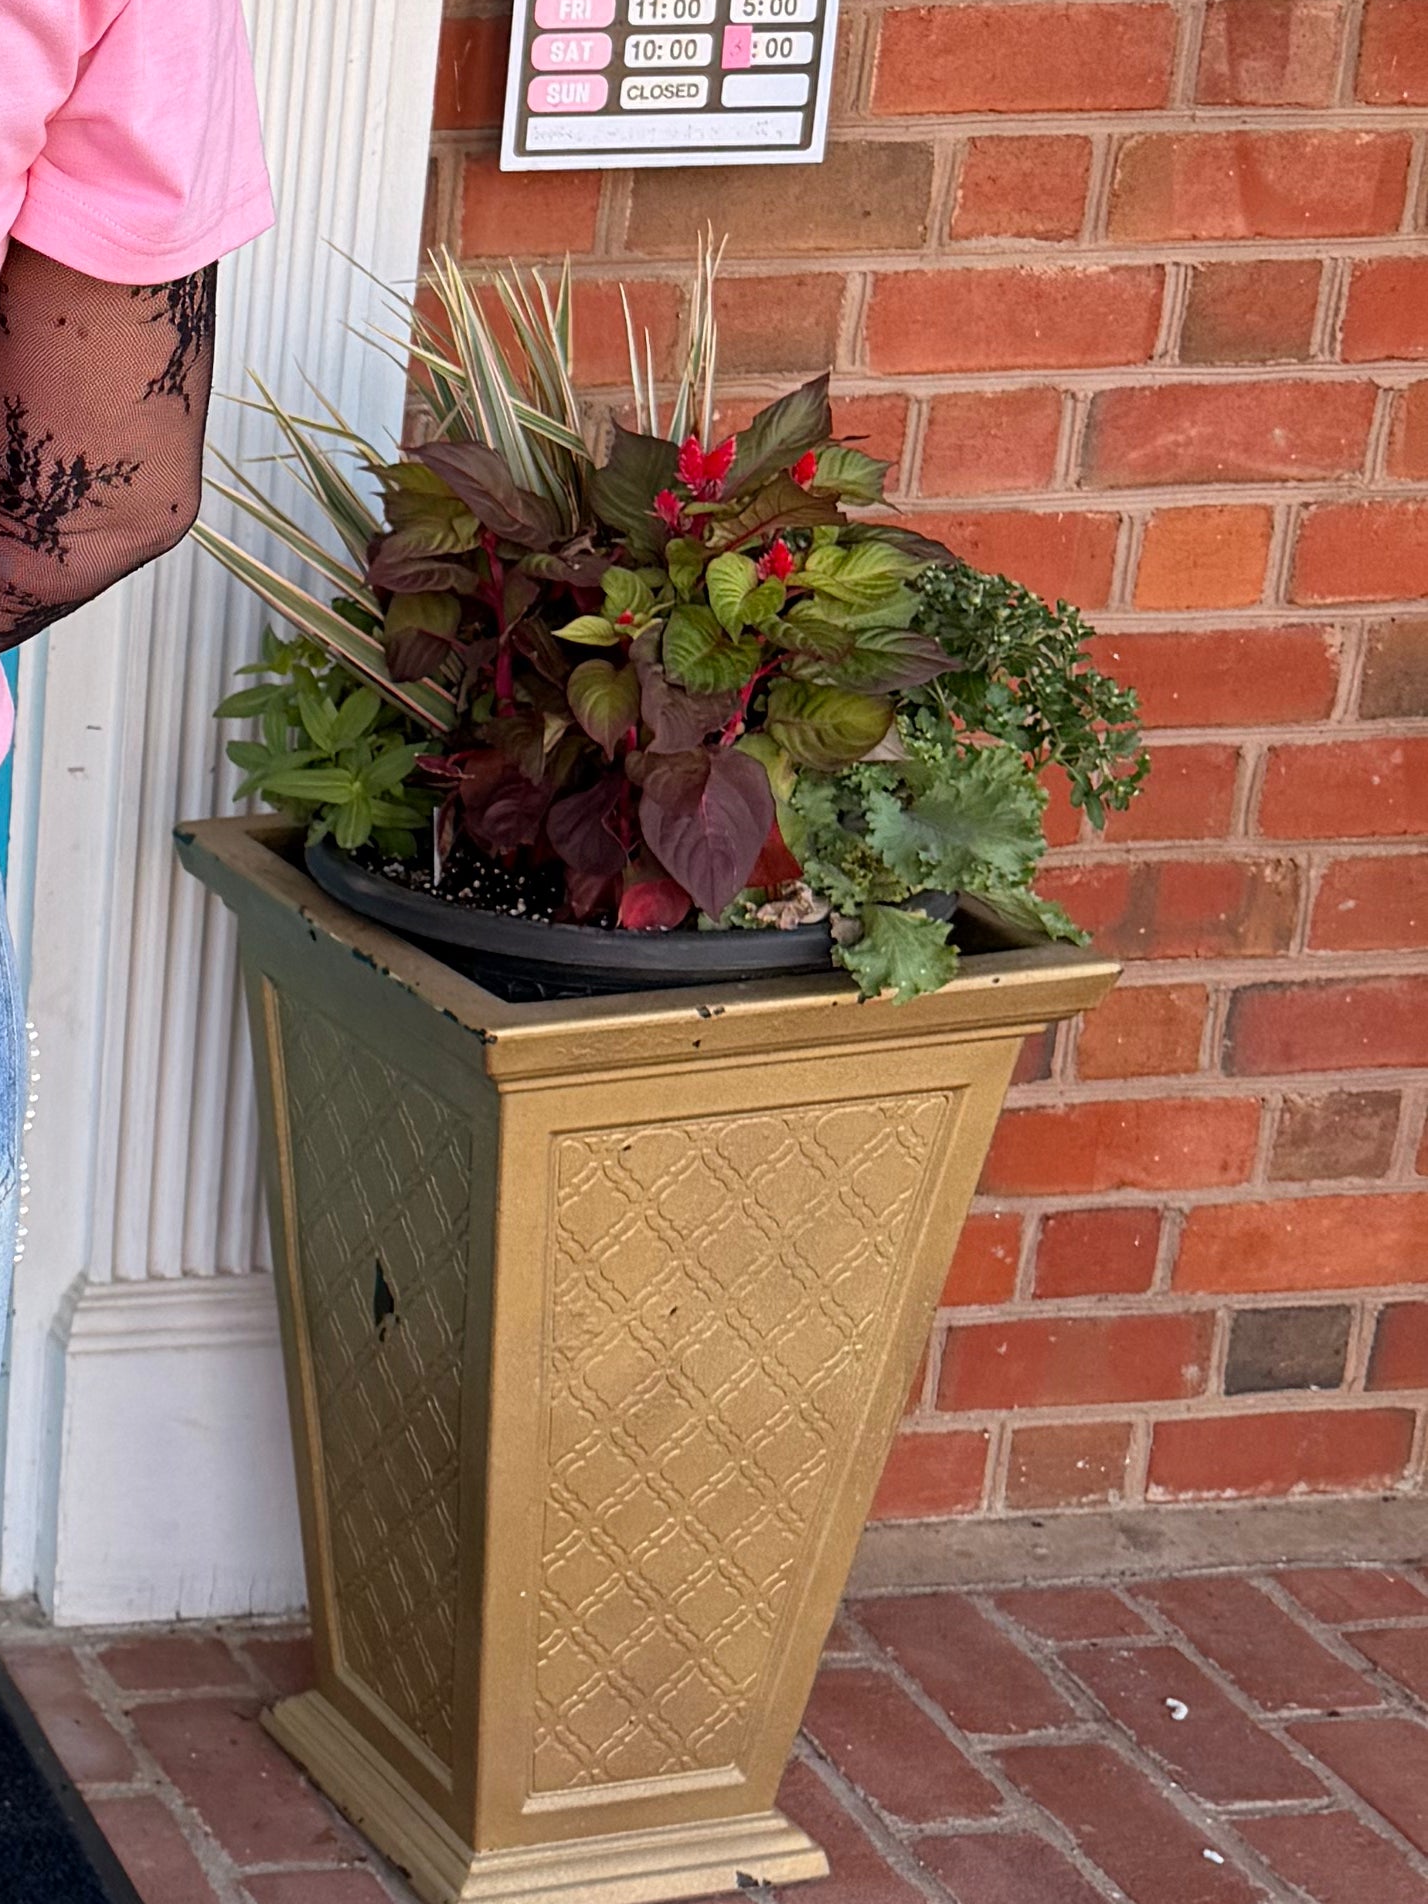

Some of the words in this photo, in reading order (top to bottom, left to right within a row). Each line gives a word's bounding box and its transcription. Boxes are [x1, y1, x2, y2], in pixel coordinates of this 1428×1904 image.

[549, 44, 593, 68] SAT
[631, 38, 698, 61] 10:00
[546, 82, 590, 105] SUN
[627, 83, 700, 101] CLOSED
